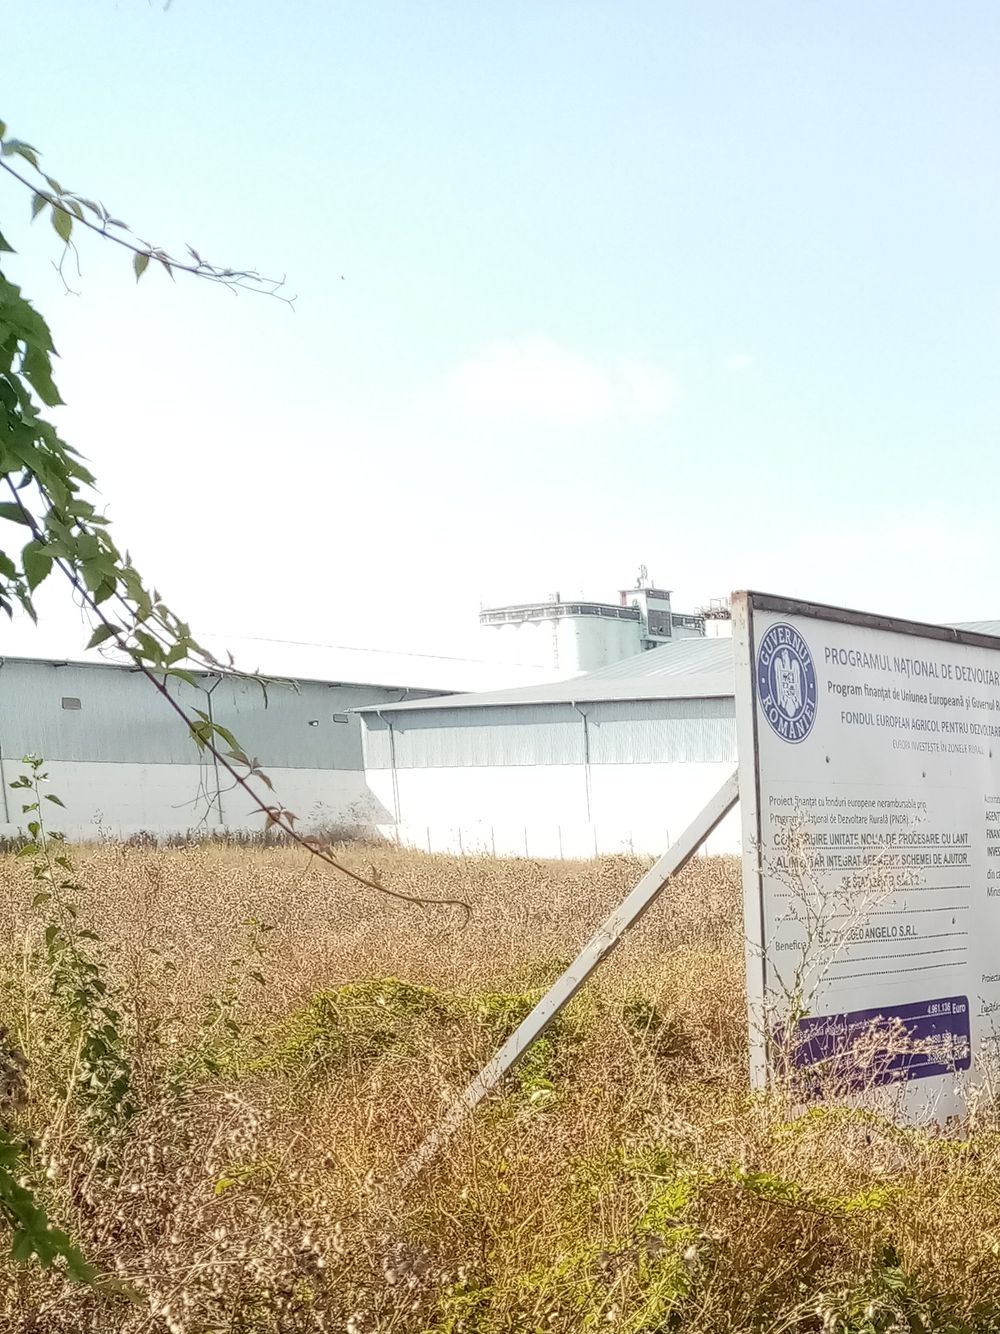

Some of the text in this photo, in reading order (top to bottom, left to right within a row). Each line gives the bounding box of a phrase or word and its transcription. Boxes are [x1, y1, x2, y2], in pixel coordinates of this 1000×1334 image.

[760, 627, 811, 672] GUVERNUL
[824, 647, 892, 671] PROGRAMUL
[942, 664, 952, 679] DE
[827, 681, 862, 697] Program
[892, 688, 900, 700] de
[901, 689, 927, 703] Uniunea
[929, 693, 964, 707] Europeană
[971, 697, 995, 711] Guvernul
[841, 711, 875, 725] FONDUL
[876, 714, 910, 729] EUROPEAN
[911, 718, 940, 732] AGRICOL
[941, 721, 968, 734] PENTRU
[969, 723, 1000, 737] DEZVOLTARE
[769, 796, 793, 806] Proiect
[826, 797, 846, 806] fonduri
[847, 799, 876, 809] europene
[830, 814, 836, 823] de
[838, 814, 868, 824] Dezvoltare
[869, 814, 888, 824] Rurală
[941, 834, 951, 844] CU
[953, 833, 968, 844] LANT
[901, 854, 932, 866] SCHEMEI
[934, 854, 942, 864] DE
[943, 853, 967, 864] AJUTOR
[987, 869, 995, 879] din
[865, 926, 898, 939] ANGELO
[952, 1003, 966, 1014] Euro
